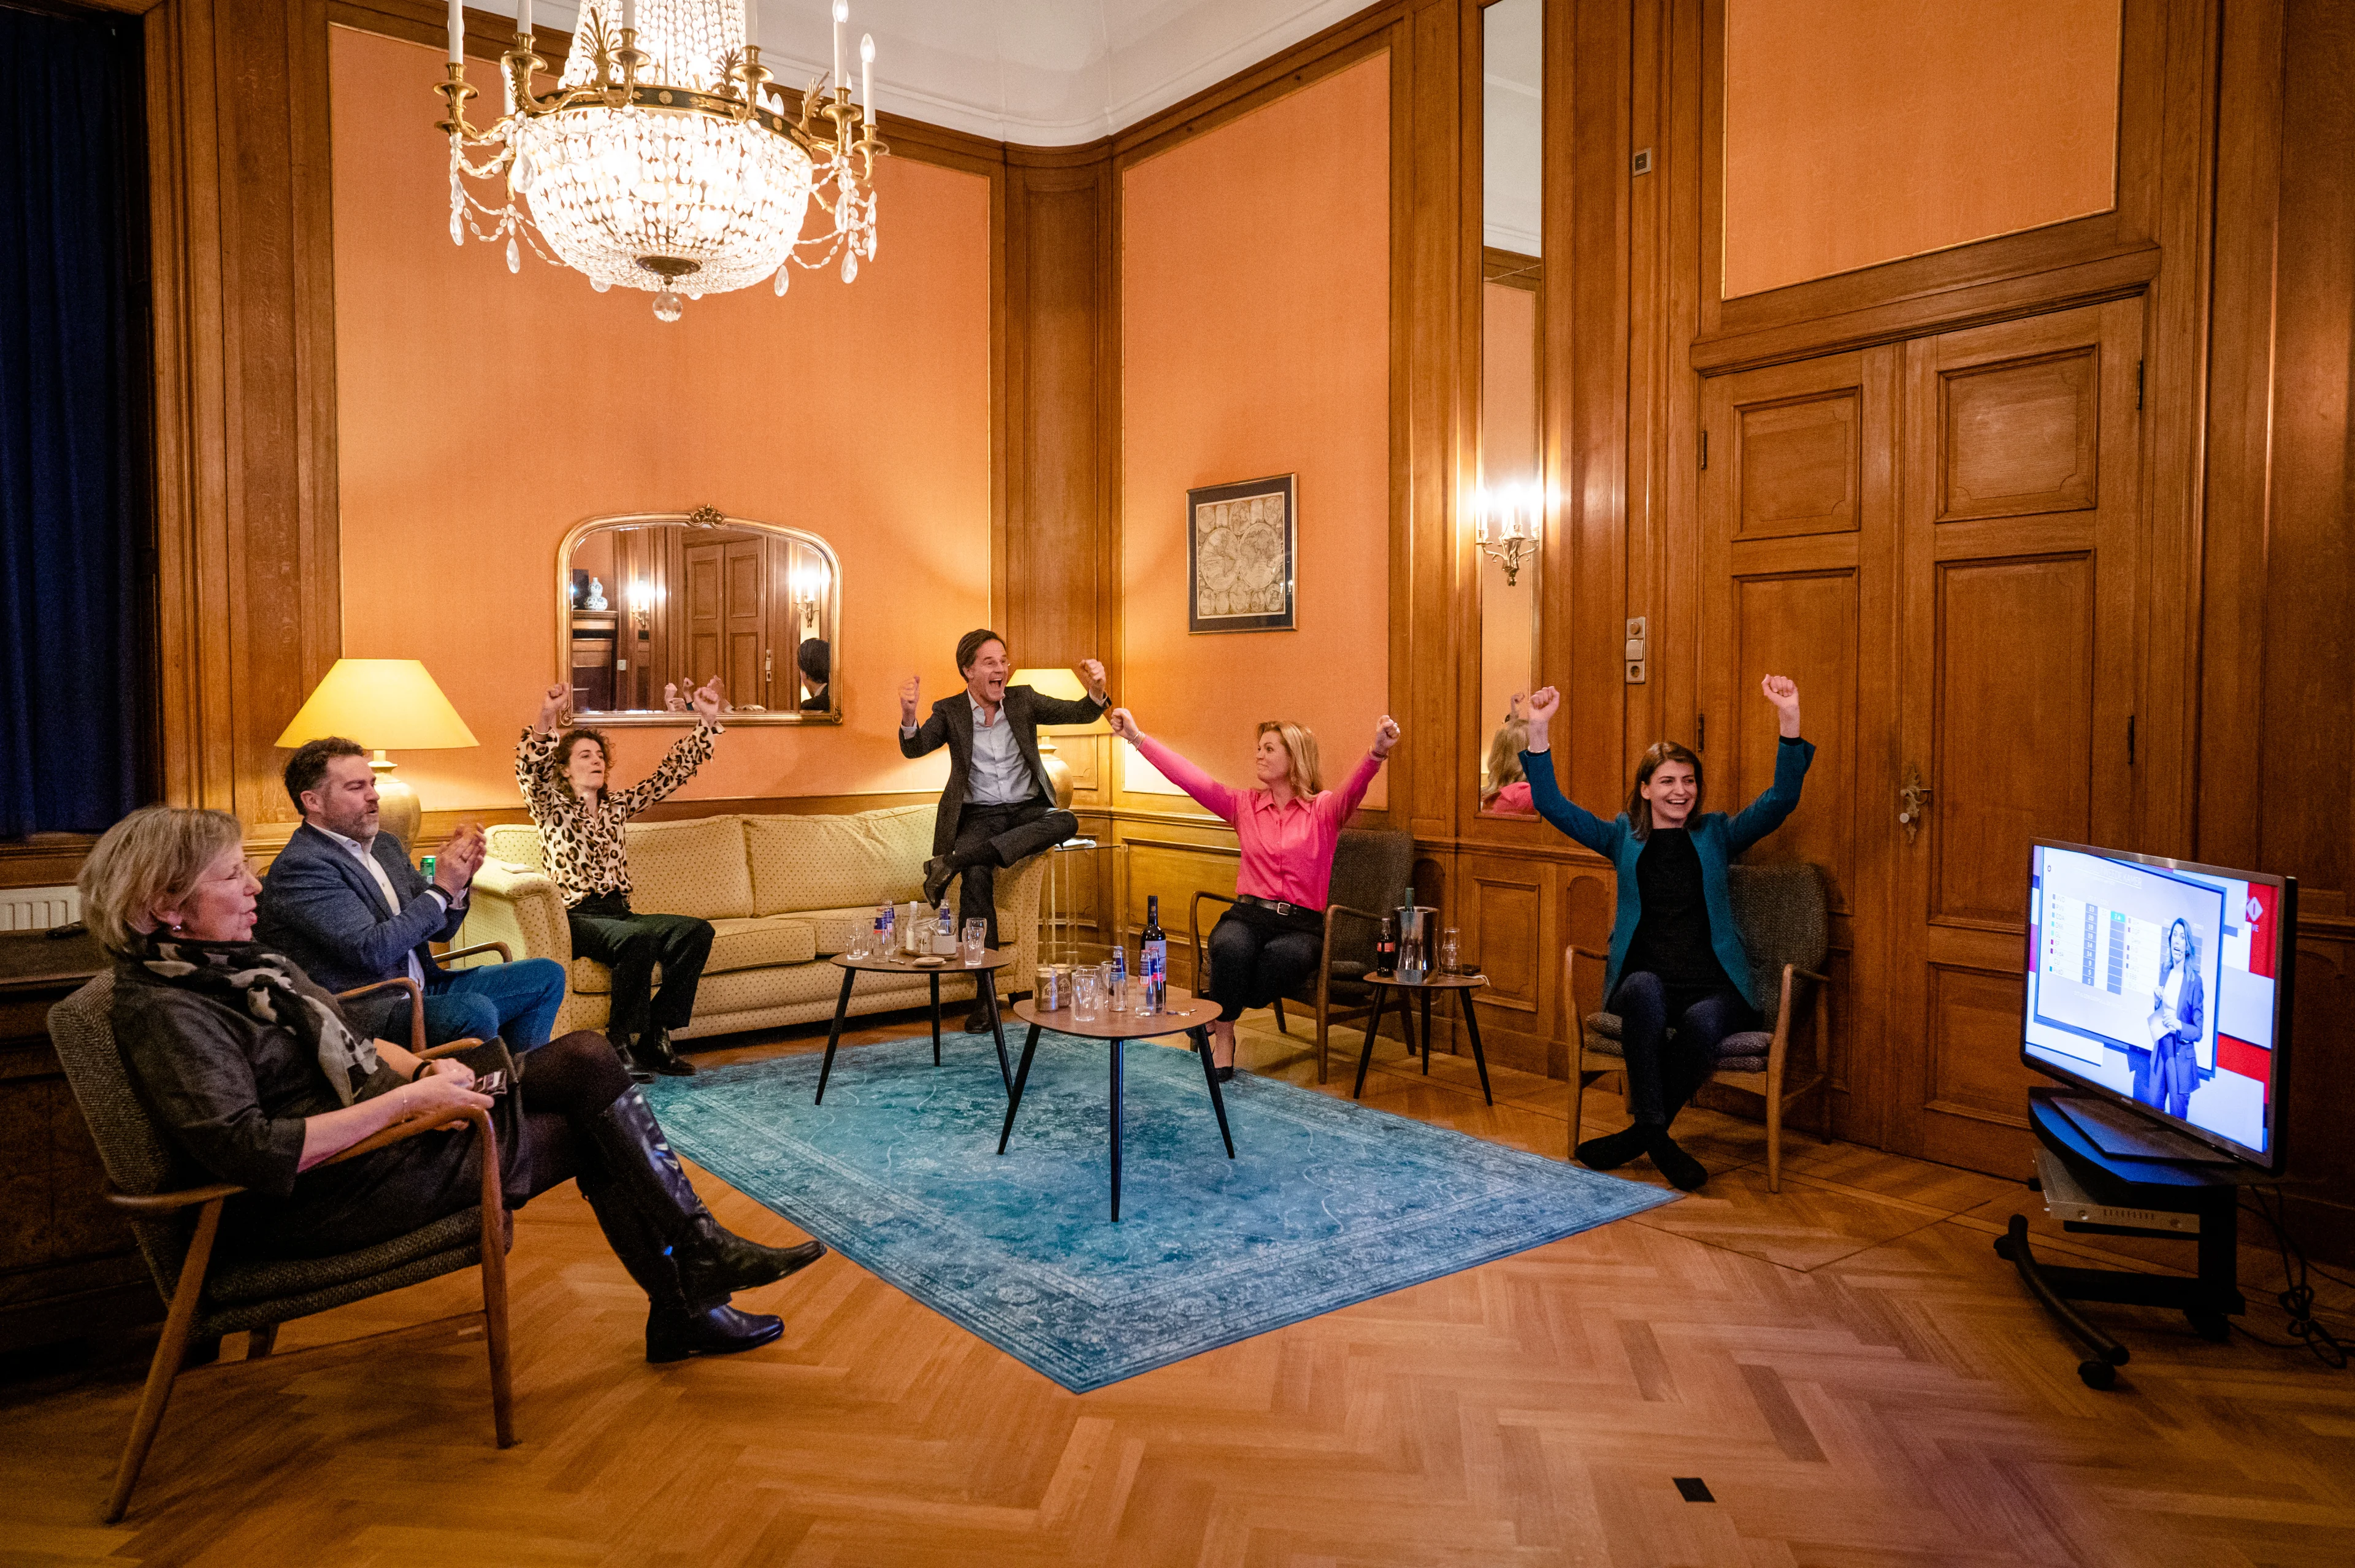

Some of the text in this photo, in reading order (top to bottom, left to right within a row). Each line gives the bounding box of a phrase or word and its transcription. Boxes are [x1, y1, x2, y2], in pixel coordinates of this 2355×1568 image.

[2100, 865, 2123, 882] TWEEDE
[2123, 873, 2142, 887] KAMER
[1044, 987, 1056, 996] Leffe
[1058, 983, 1070, 993] Leffe
